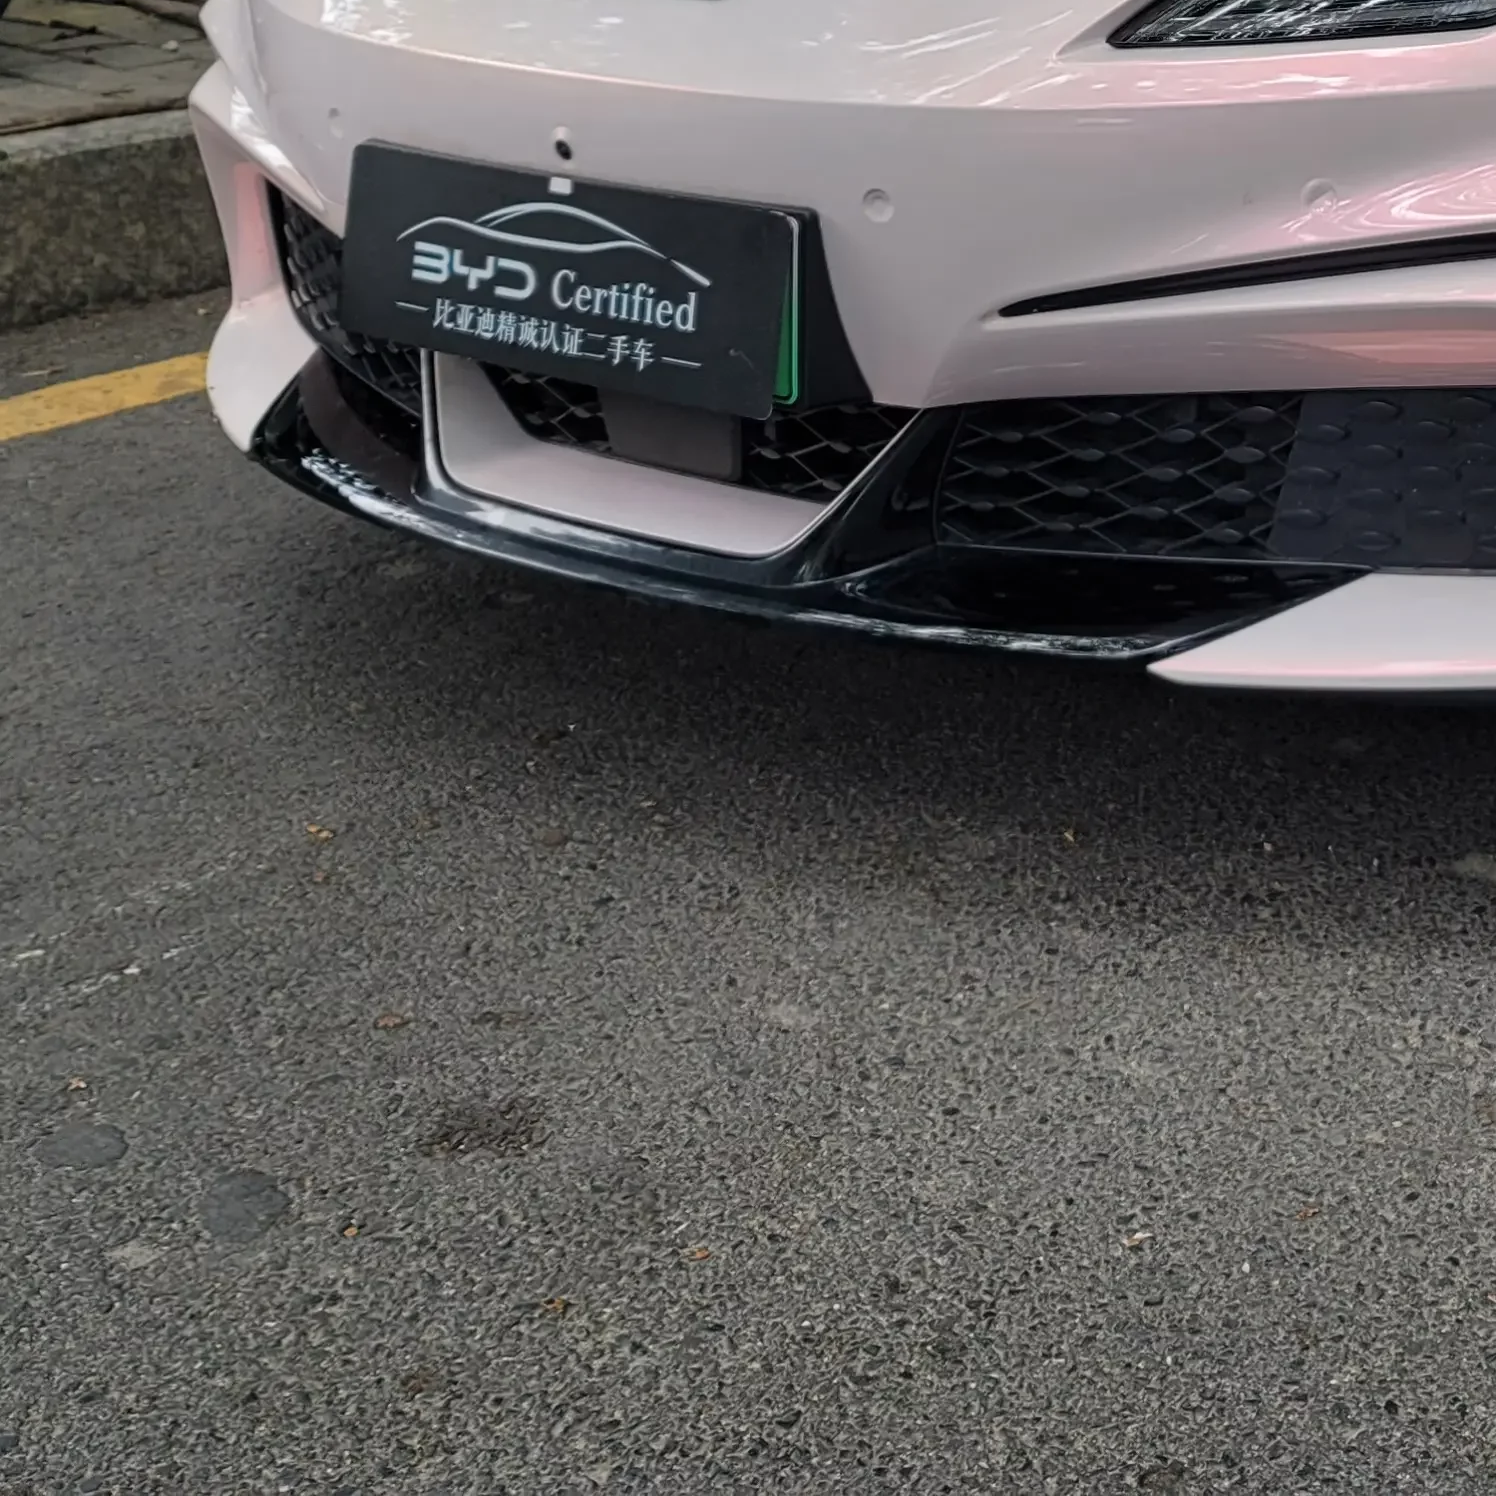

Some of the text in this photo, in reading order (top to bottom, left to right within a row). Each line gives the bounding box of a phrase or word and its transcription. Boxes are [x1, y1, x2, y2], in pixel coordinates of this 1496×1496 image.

[411, 240, 697, 333] BYD Certified
[431, 297, 655, 372] 比亚迪精诚认证二手车
